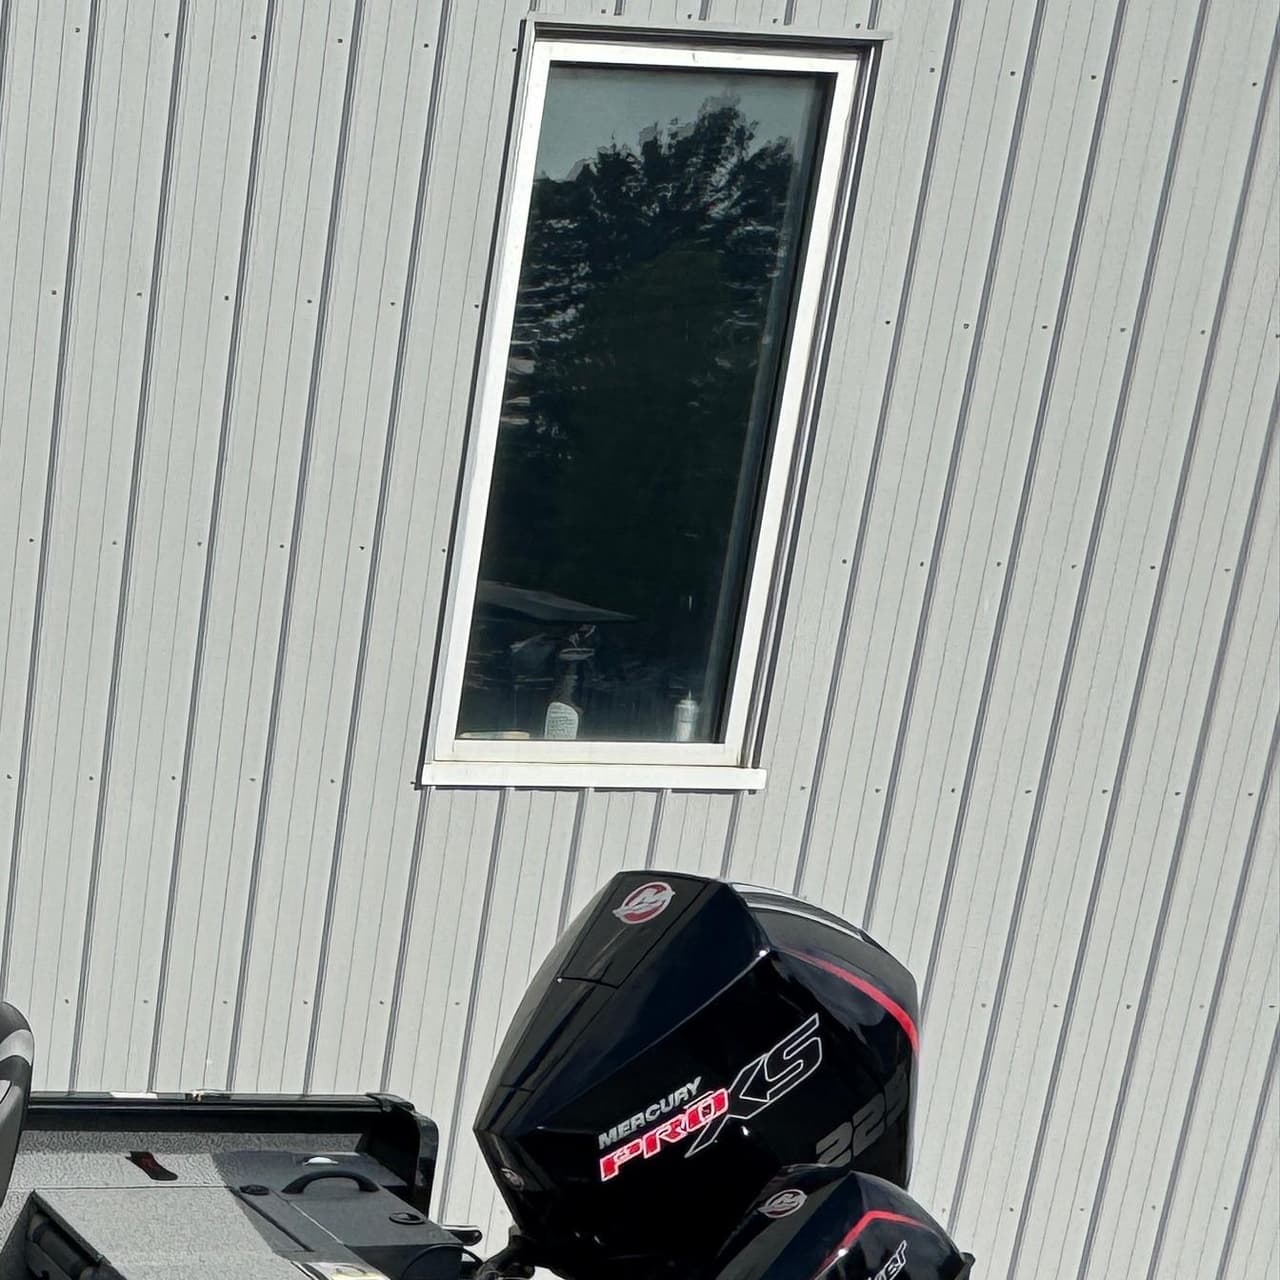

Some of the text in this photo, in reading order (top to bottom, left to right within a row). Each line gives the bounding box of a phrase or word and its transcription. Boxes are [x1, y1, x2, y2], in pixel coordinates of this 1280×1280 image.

[598, 1076, 702, 1149] MERCURY
[600, 1012, 823, 1182] PRO XS
